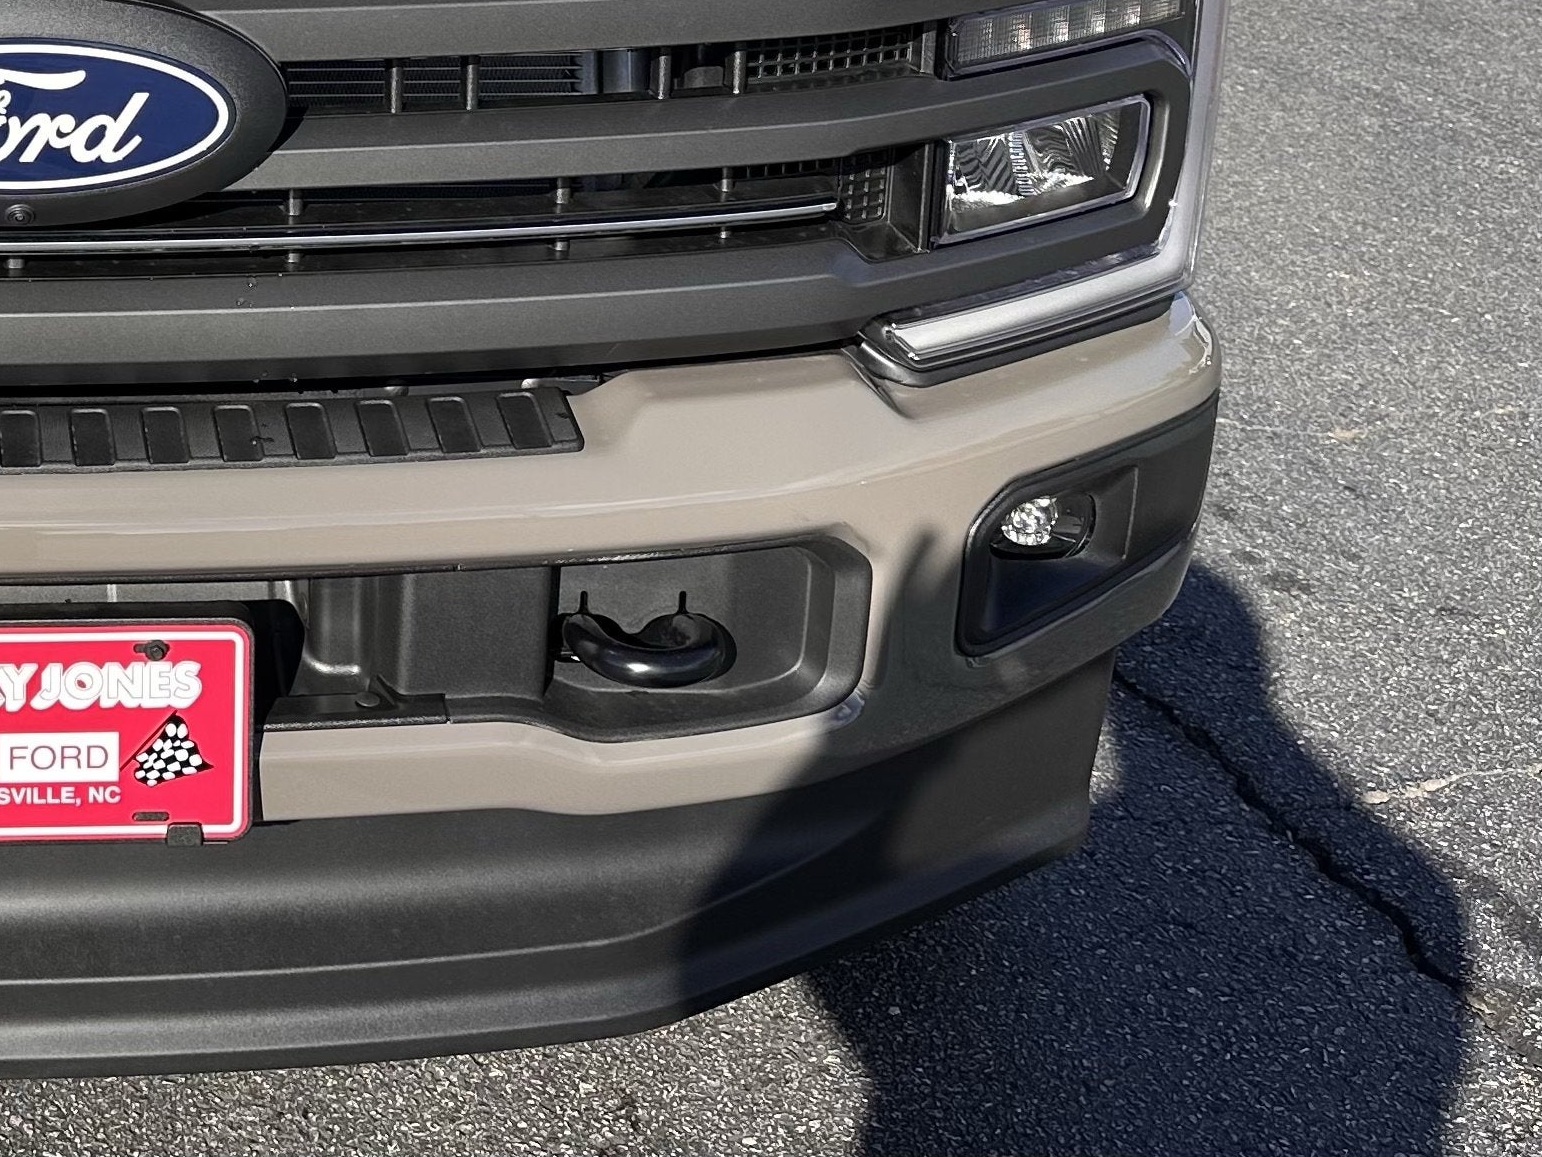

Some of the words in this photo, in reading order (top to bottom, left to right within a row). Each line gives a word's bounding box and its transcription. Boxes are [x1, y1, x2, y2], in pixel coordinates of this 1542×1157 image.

[30, 660, 203, 710] JONES
[9, 745, 109, 770] FORD
[88, 785, 121, 804] NC
